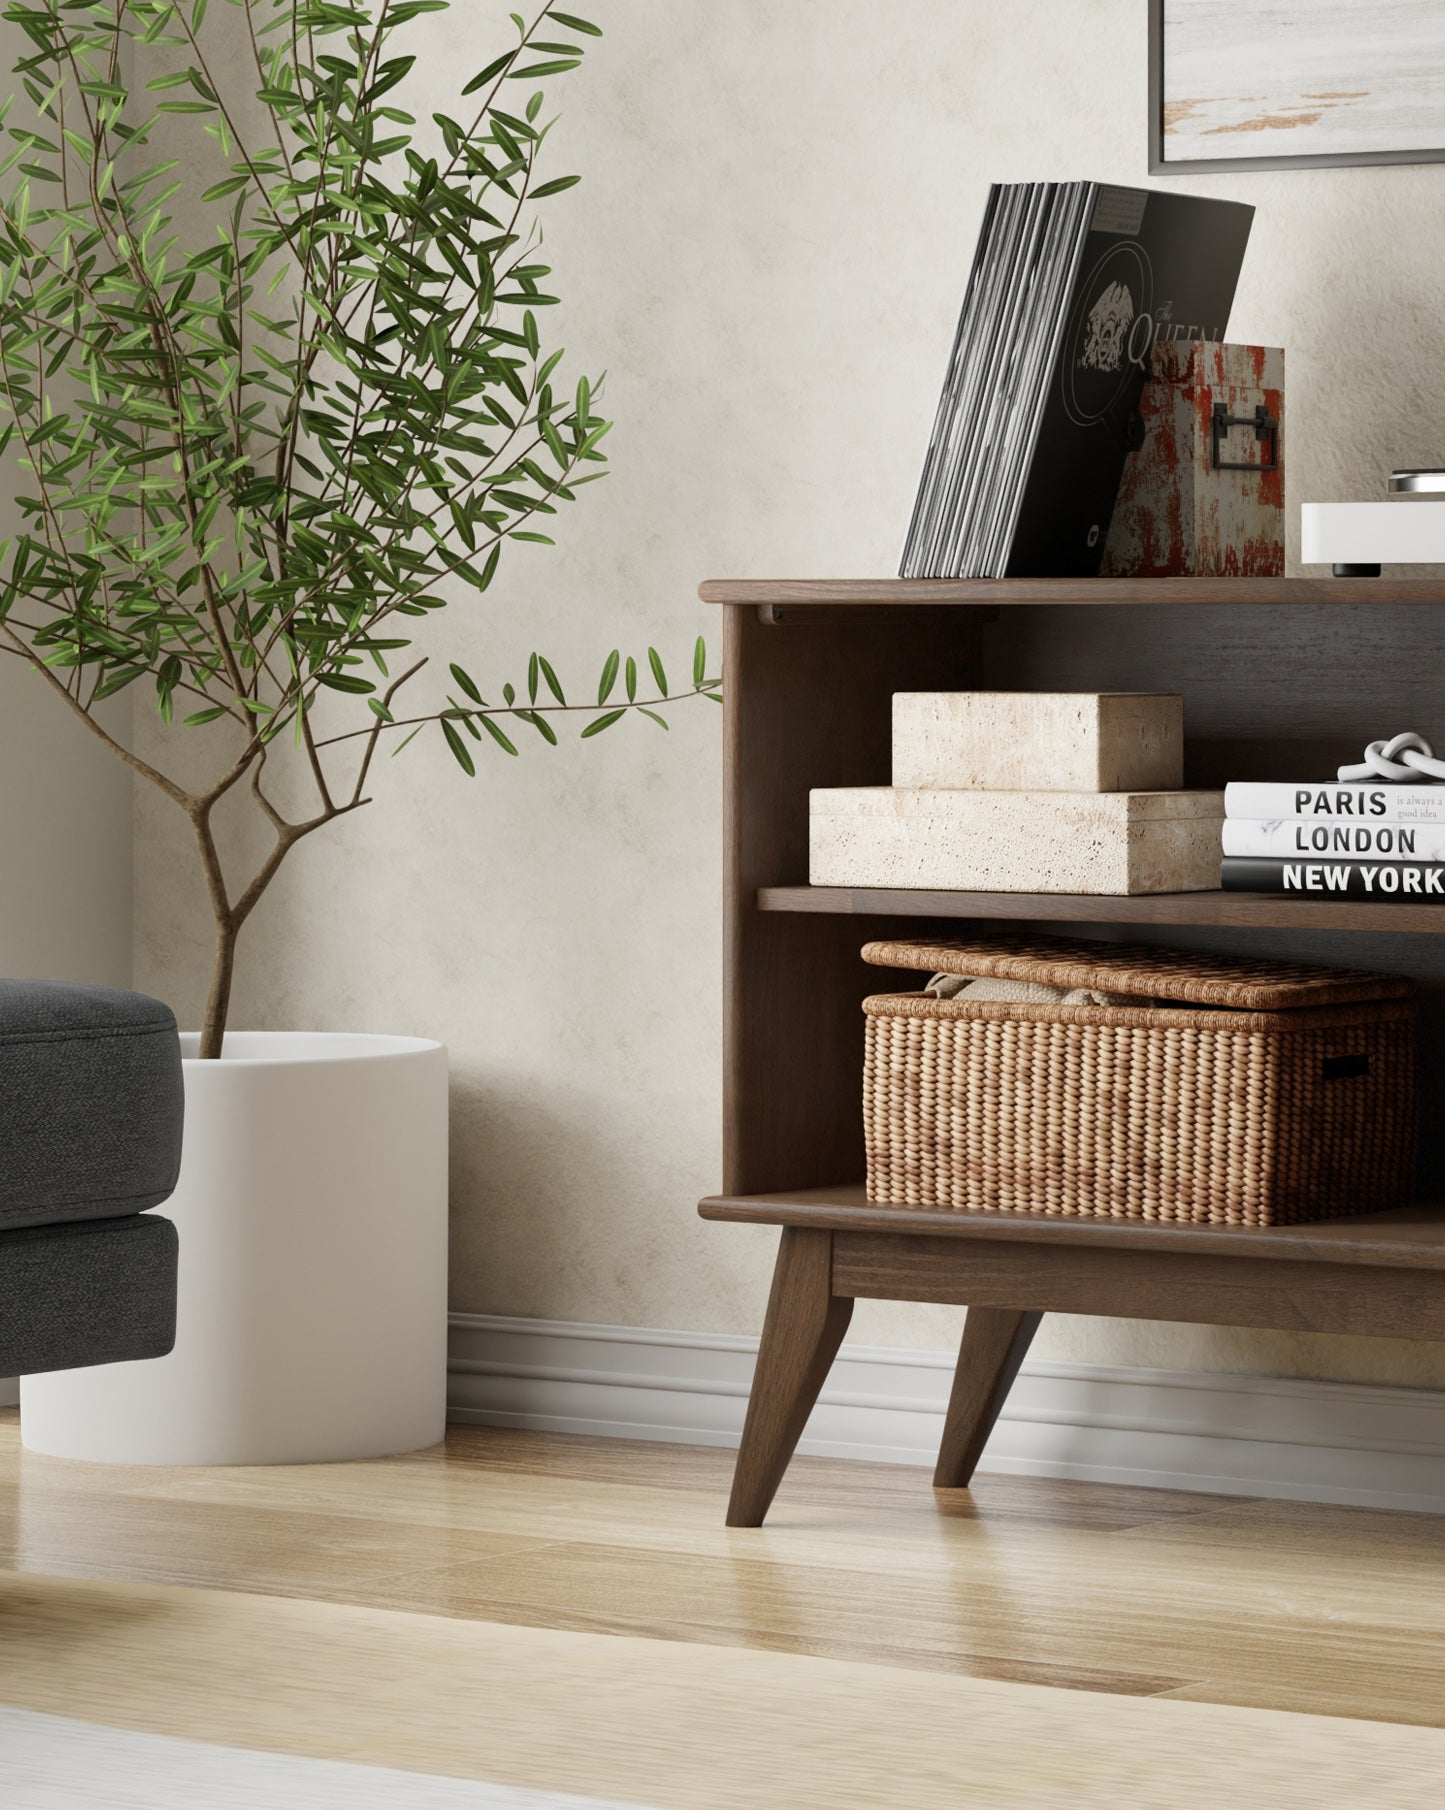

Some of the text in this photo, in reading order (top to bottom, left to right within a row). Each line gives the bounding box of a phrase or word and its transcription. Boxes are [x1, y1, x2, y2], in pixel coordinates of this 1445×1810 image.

[1295, 790, 1387, 816] PARIS
[1397, 795, 1405, 806] is
[1407, 795, 1436, 808] always
[1397, 808, 1438, 820] good idea
[1296, 826, 1416, 854] LONDON
[1282, 864, 1445, 894] NEW YORK
